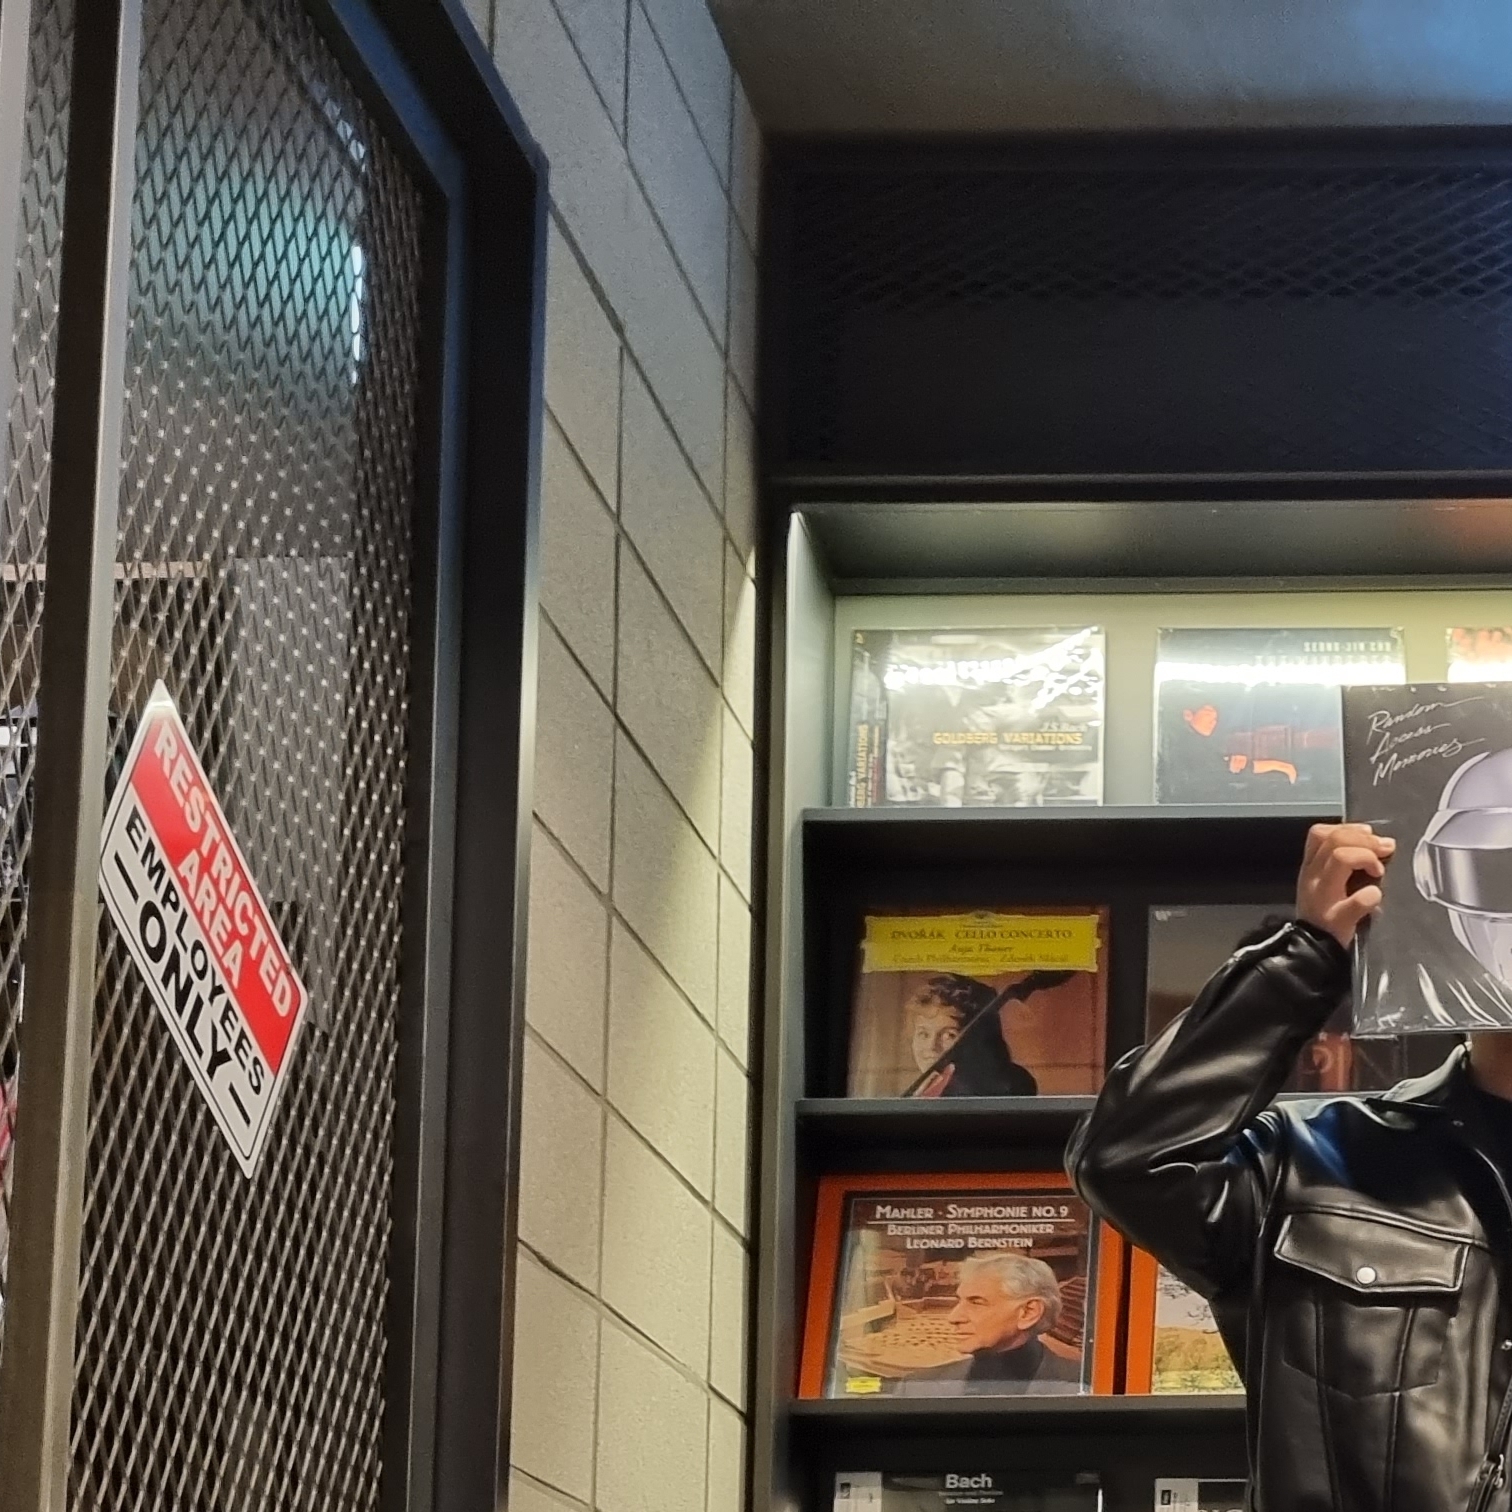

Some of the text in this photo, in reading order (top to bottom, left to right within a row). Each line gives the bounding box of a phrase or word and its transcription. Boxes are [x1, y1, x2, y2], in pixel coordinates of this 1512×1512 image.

[932, 731, 1083, 745] GOLDBERG VARIATIONS
[1366, 697, 1485, 745] Random
[1370, 722, 1452, 765] Access
[1372, 737, 1487, 787] Memories
[154, 721, 294, 1018] RESTRICTED
[177, 849, 243, 986] AREA
[1000, 930, 1073, 940] CONCERTO
[125, 804, 266, 1096] EMPLOYEES
[138, 901, 232, 1083] ONLY
[875, 1203, 1069, 1219] MAHLER SYMPHONIE NO. 9
[887, 1222, 1055, 1236] BERLINER PHILHARMONIKER
[906, 1236, 1033, 1250] LEONARD BERNSTEIN
[945, 1473, 993, 1488] Bach
